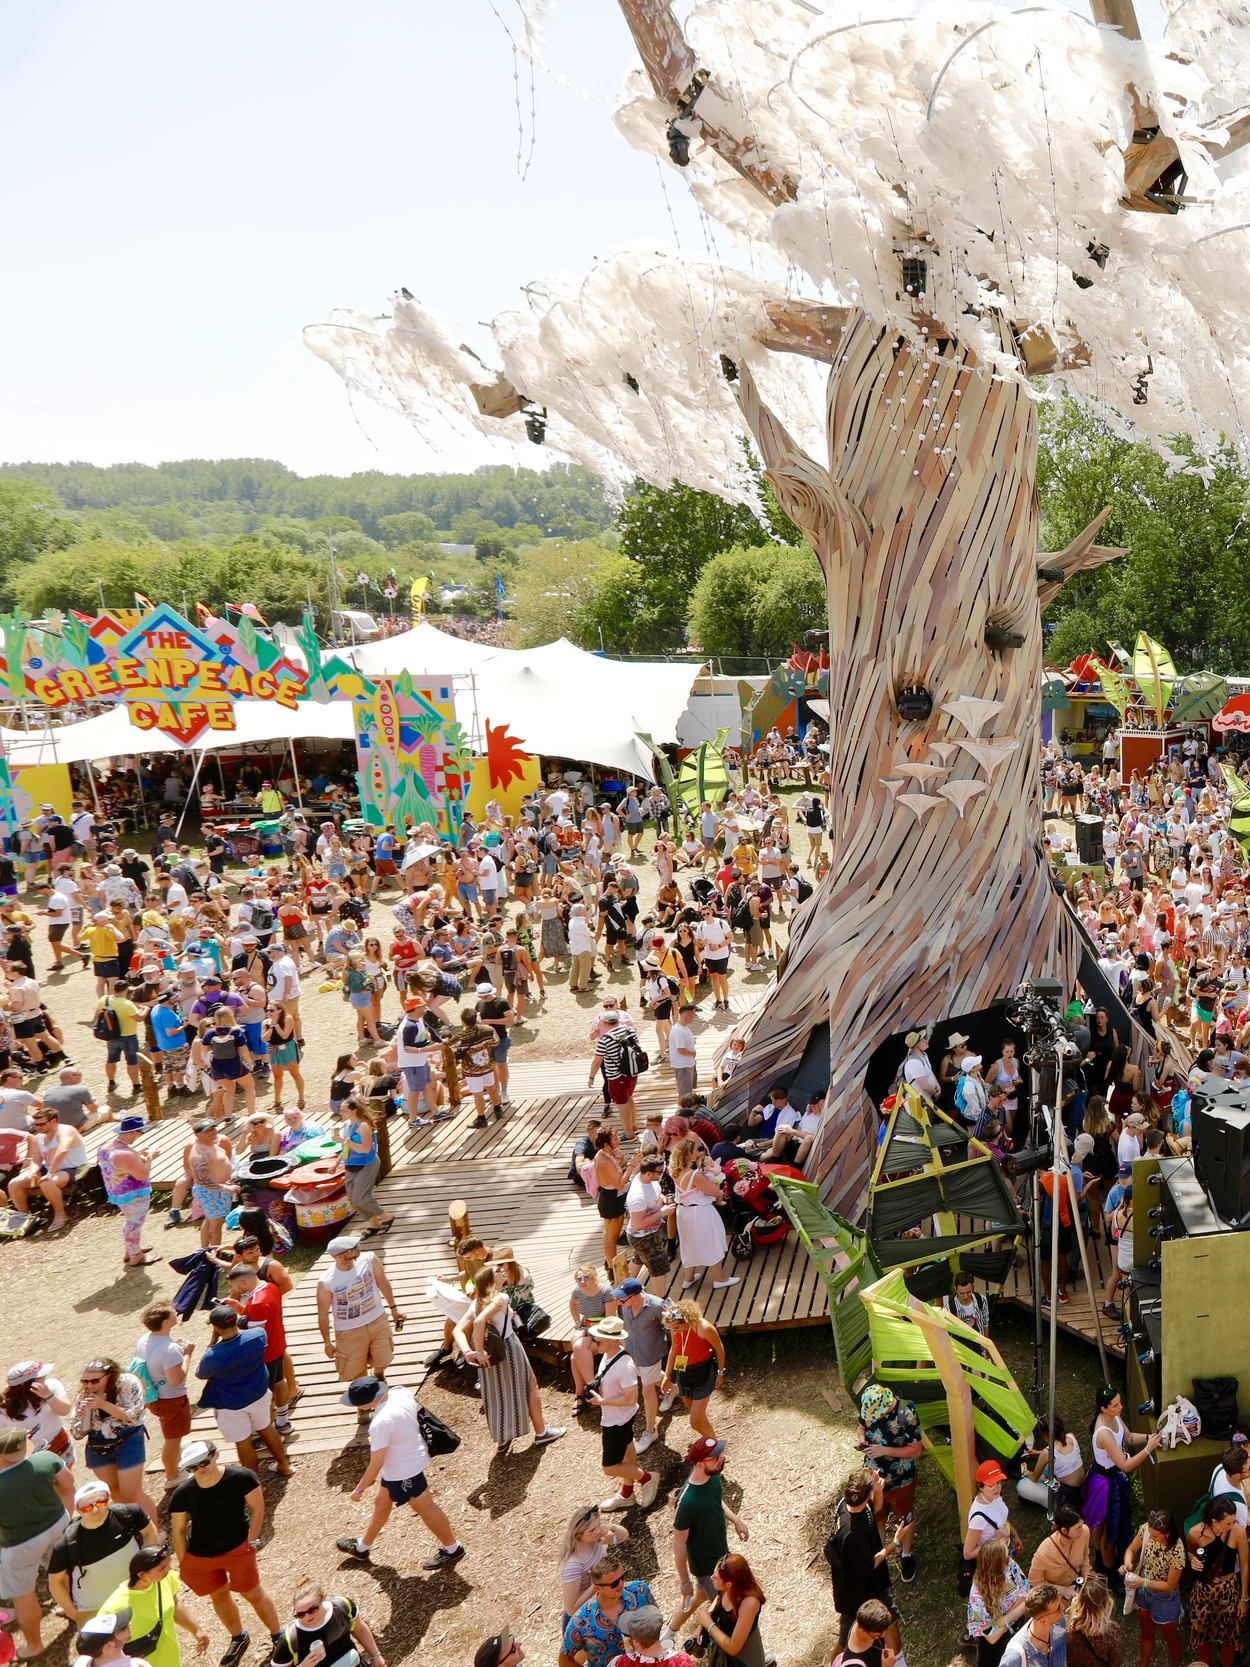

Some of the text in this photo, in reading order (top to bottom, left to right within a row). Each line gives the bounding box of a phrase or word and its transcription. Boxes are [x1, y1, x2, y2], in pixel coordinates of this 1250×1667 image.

[141, 631, 192, 650] THE
[34, 657, 307, 711] GREENPEACE
[128, 701, 236, 731] CAFE
